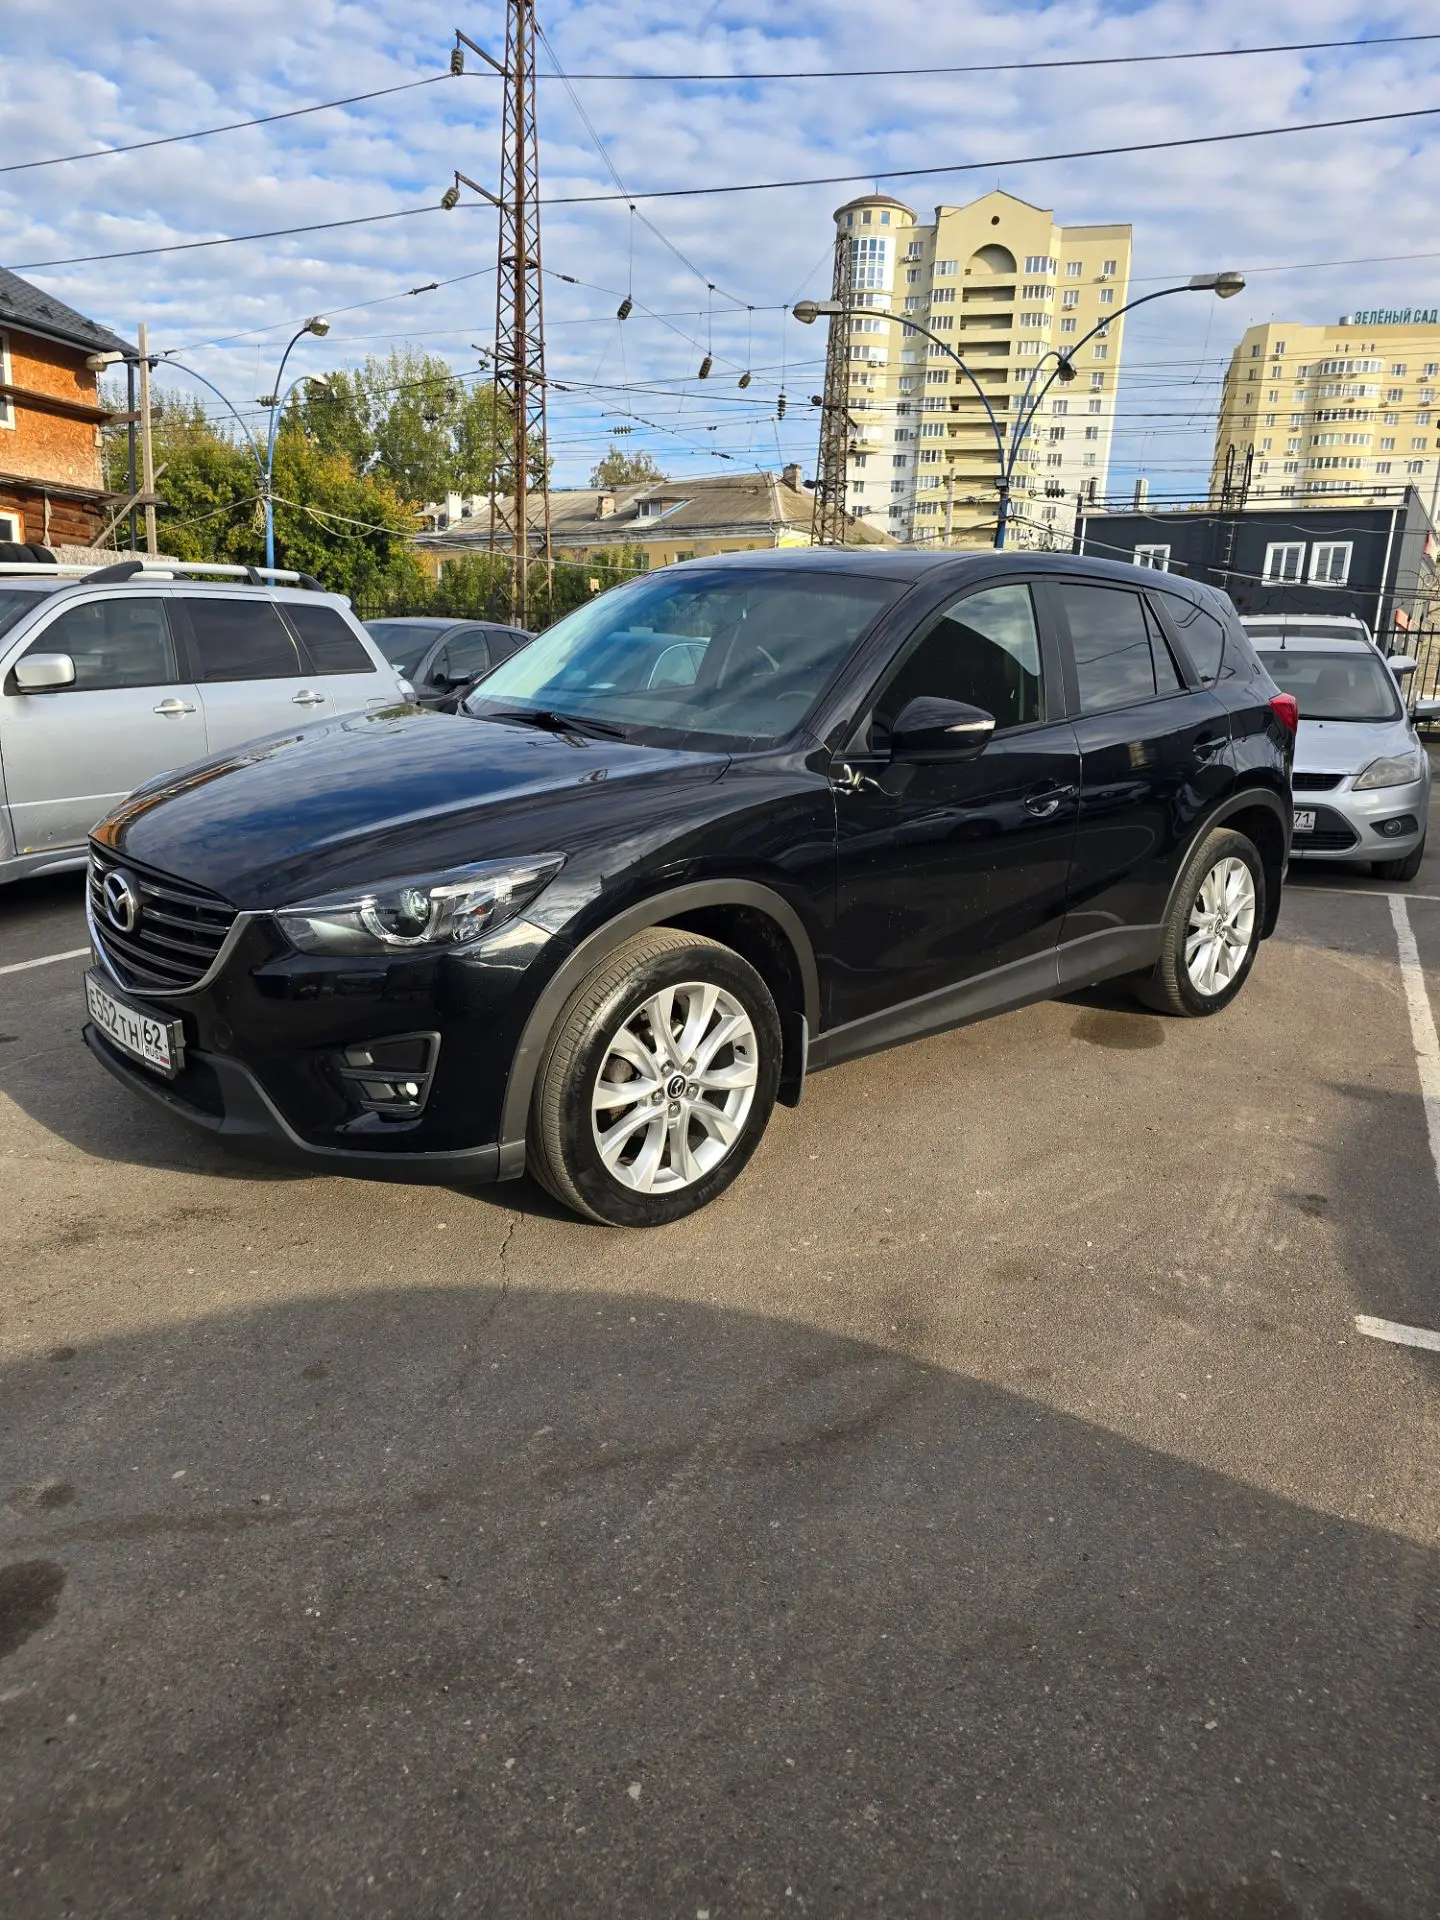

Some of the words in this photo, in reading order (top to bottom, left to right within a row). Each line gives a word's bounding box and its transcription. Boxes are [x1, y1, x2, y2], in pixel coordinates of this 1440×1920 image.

[1355, 307, 1412, 325] ЗЕЛЁНЫЙ
[1413, 309, 1438, 324] САД
[1294, 812, 1310, 824] 71
[143, 1019, 163, 1052] 62
[145, 1045, 160, 1060] RUS
